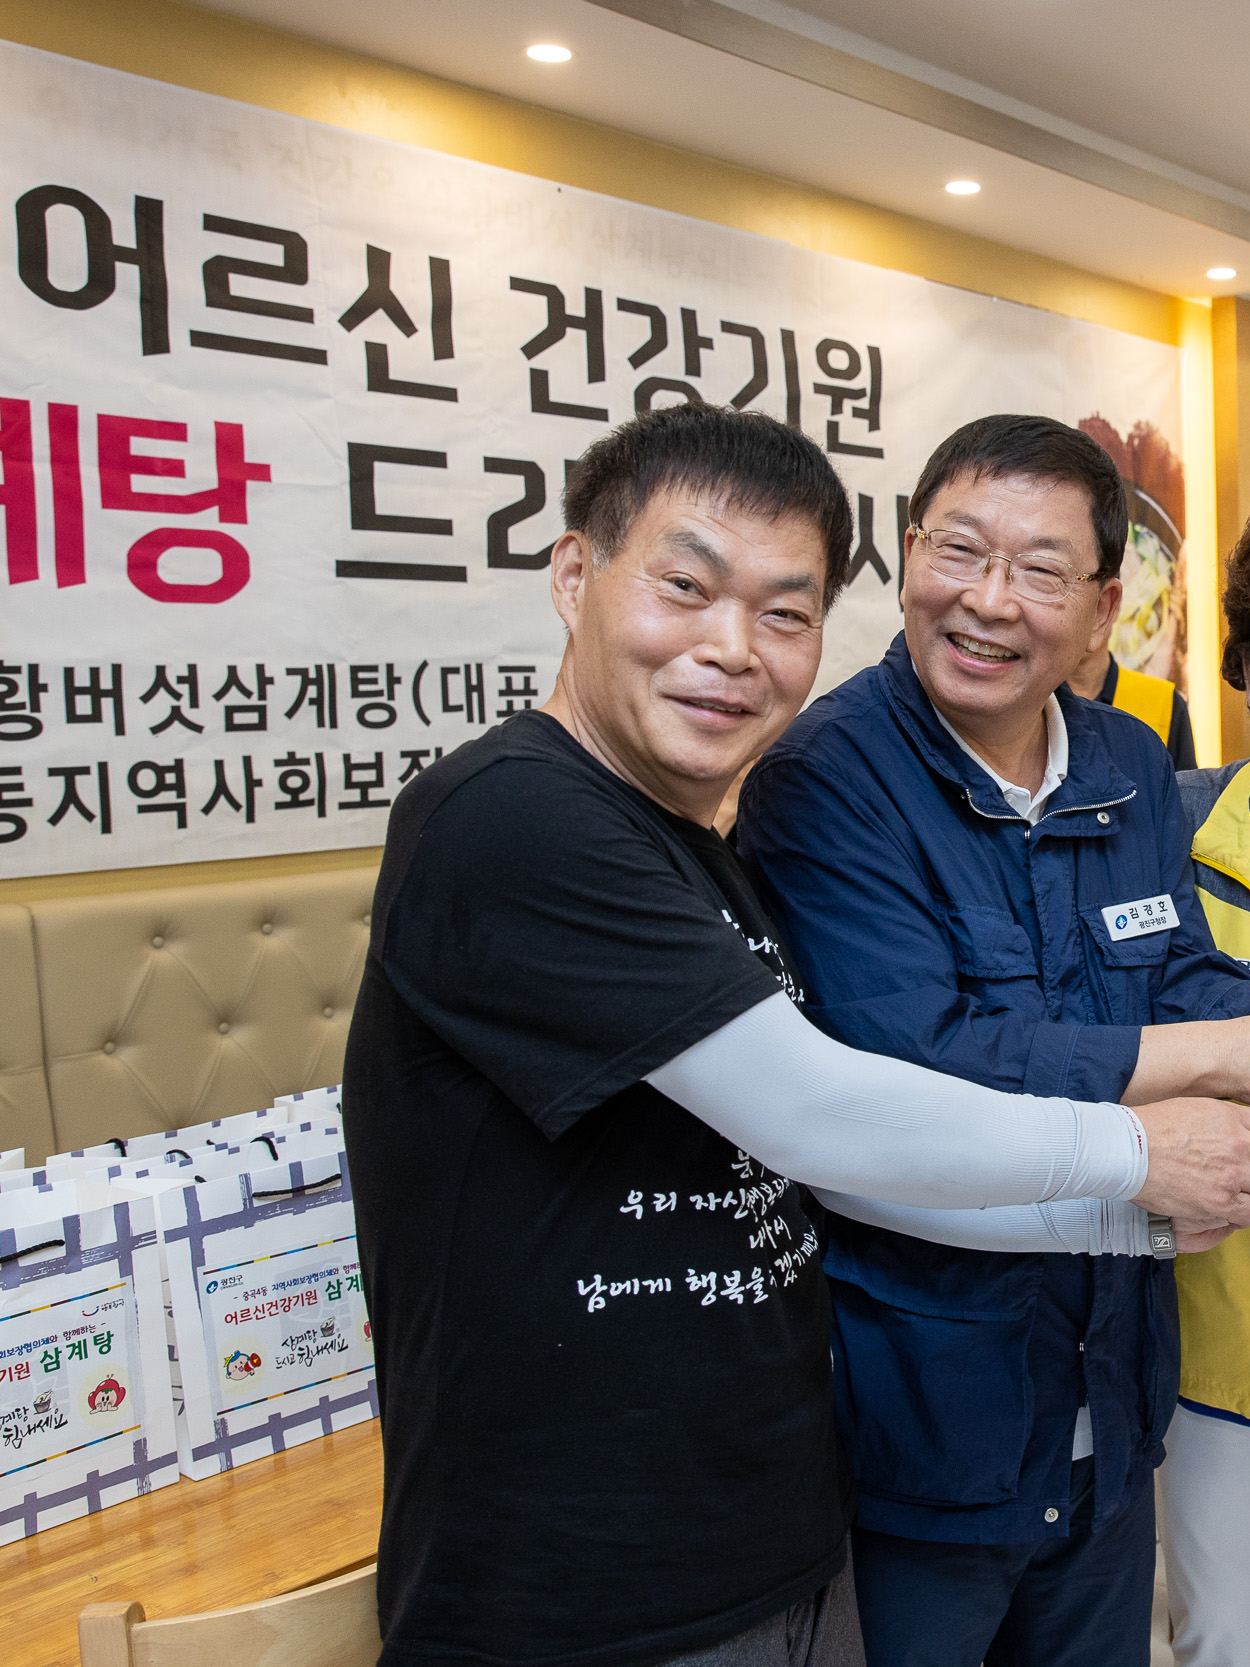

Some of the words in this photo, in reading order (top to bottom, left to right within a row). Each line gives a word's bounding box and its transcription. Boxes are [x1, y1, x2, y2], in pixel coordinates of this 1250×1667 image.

[15, 184, 458, 402] 어르신
[508, 276, 884, 459] 건강기원
[1129, 901, 1168, 919] 김경호
[1138, 916, 1167, 929] 광진구청장
[620, 1190, 677, 1220] 우리
[242, 1287, 268, 1301] 중곡4동
[577, 1274, 672, 1313] 남에게
[685, 1267, 768, 1306] 행복을
[224, 1290, 318, 1325] 어르신건강기원
[63, 1324, 97, 1341] 함께하는
[40, 1330, 114, 1373] 삼계탕
